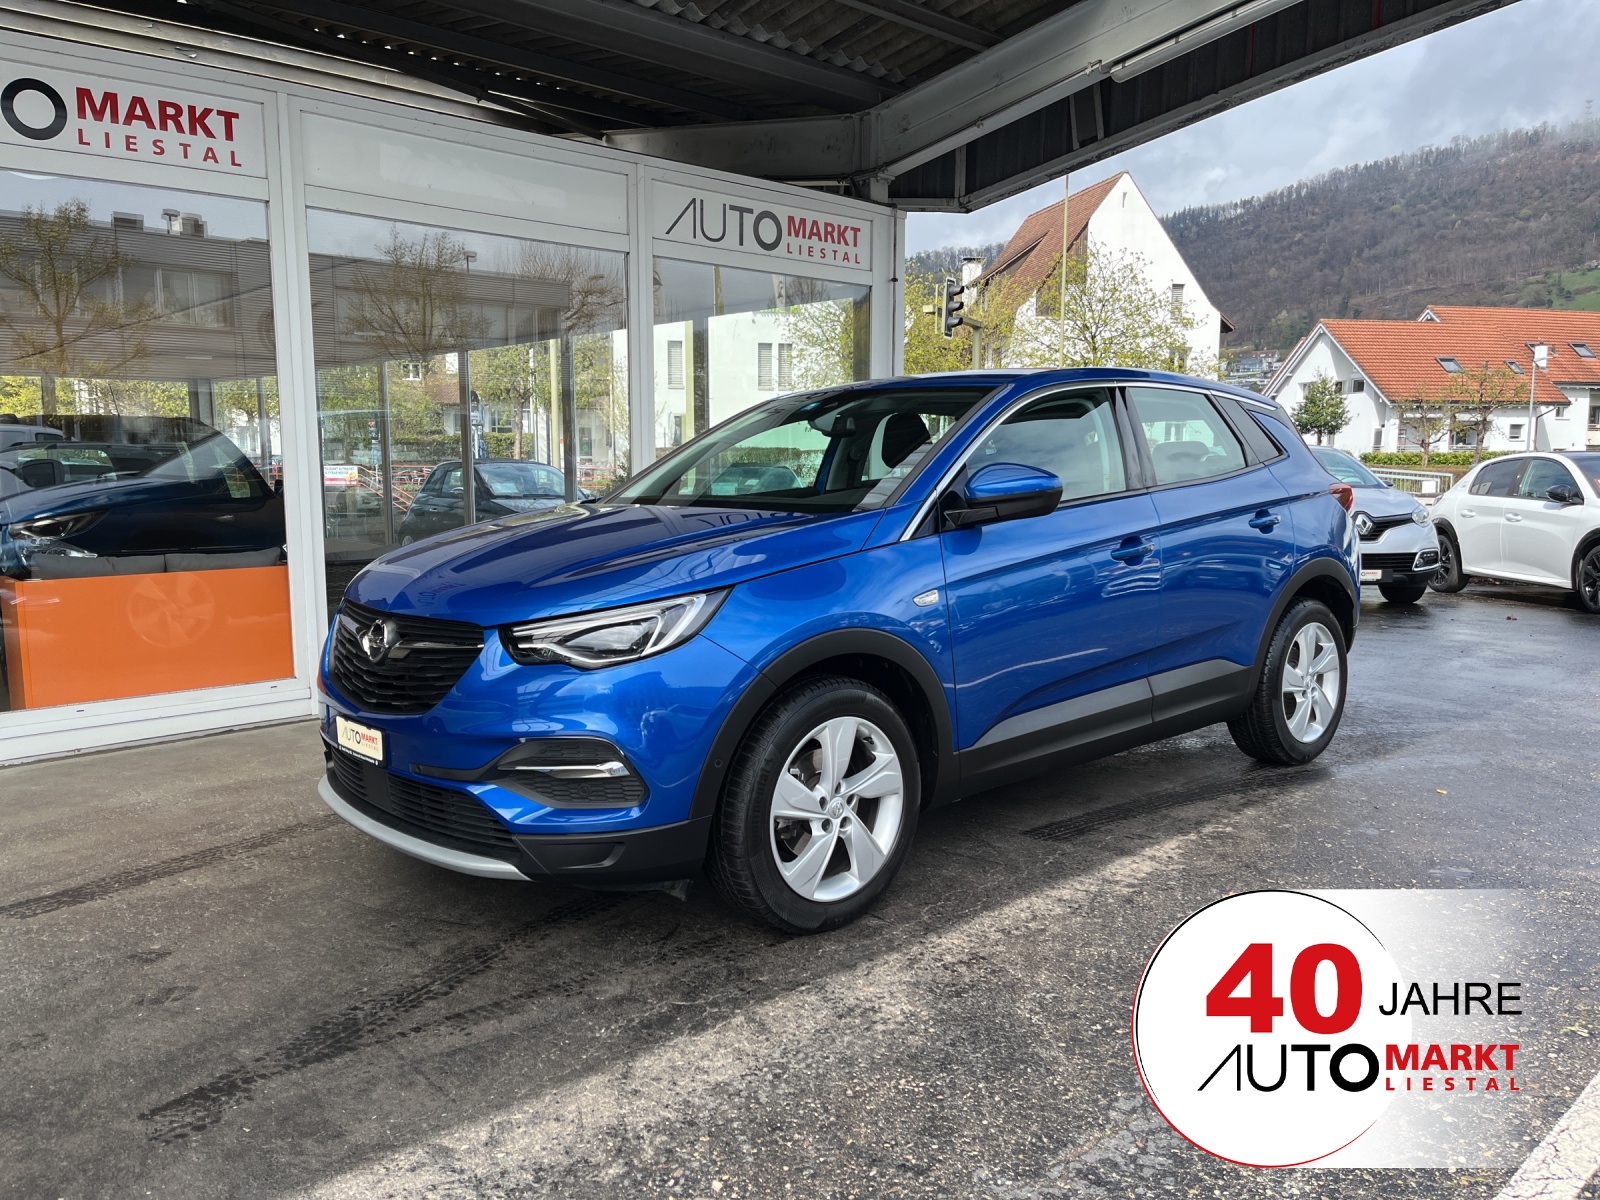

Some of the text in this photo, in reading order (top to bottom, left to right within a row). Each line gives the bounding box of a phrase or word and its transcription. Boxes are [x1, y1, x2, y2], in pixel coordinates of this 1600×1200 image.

[76, 87, 240, 142] MARKT
[78, 129, 242, 167] LIESTAL
[665, 198, 861, 251] AUTO MARKT
[787, 242, 861, 264] LIESTAL
[361, 733, 377, 746] MARKT
